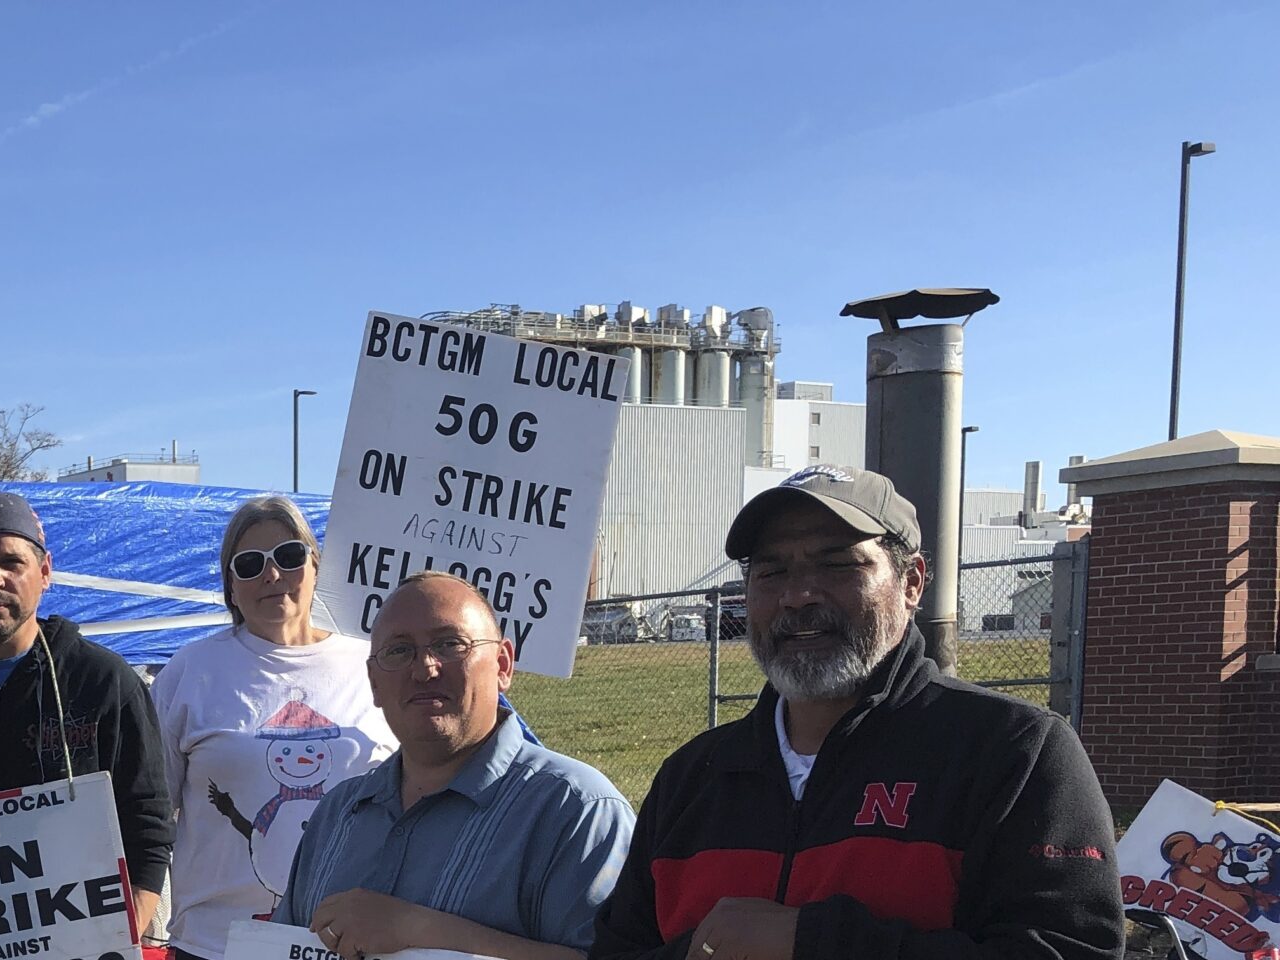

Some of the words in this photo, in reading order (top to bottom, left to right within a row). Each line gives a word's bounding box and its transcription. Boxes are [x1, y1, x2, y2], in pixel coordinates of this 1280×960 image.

[366, 316, 486, 376] BCTGM
[514, 342, 619, 402] LOCAL
[359, 449, 407, 496] ON
[434, 466, 572, 530] STRIKE
[402, 513, 528, 558] AGAINST
[854, 782, 917, 828] N
